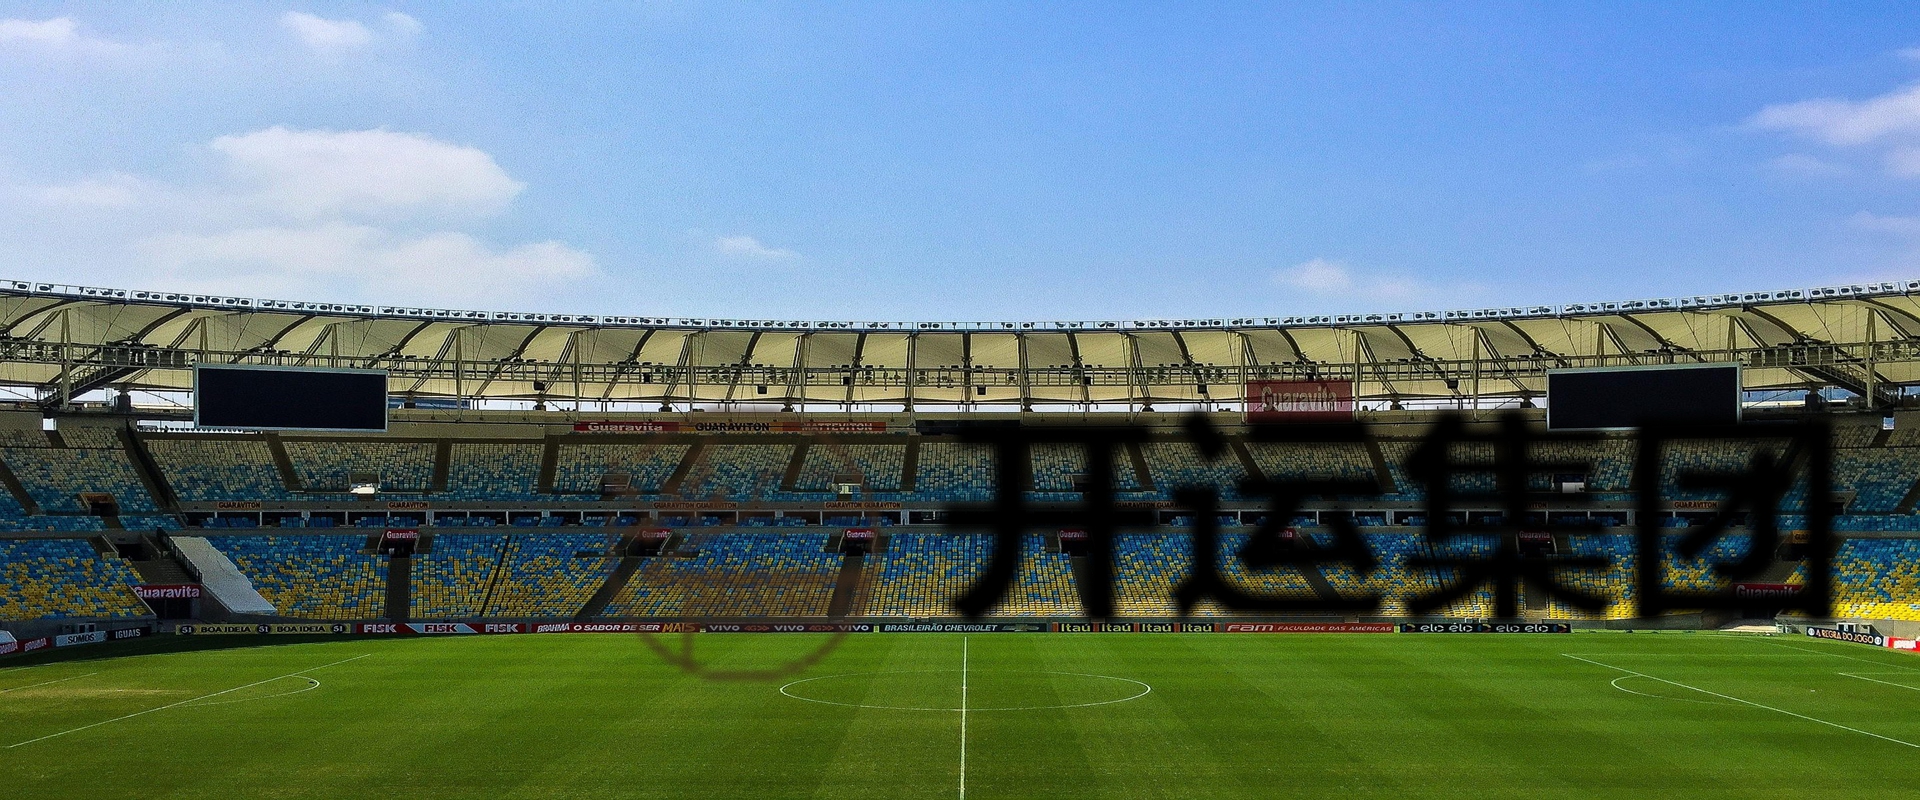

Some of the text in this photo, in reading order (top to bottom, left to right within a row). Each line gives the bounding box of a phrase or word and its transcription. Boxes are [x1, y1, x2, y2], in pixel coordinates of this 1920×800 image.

[1261, 385, 1338, 412] Guaravita
[588, 421, 663, 432] Guaravita
[695, 421, 770, 432] GUARAVITON
[258, 625, 269, 633] 51
[332, 625, 343, 633] 51
[363, 623, 519, 633] FISK FISK FISK
[537, 622, 570, 633] BRAHMA
[662, 622, 696, 633] MAIS
[884, 622, 998, 632] BRASILEIRÃO CHEVROLET
[1061, 623, 1091, 632] Itaú
[1101, 623, 1132, 632] Itaú
[1142, 623, 1172, 632] Itaú
[1182, 623, 1212, 632] Itaú
[1420, 623, 1549, 632] elo elo elo elo
[67, 633, 95, 644] SOMOS
[115, 628, 141, 639] IGUAIS
[1815, 629, 1874, 644] A REGRA DO JOGO
